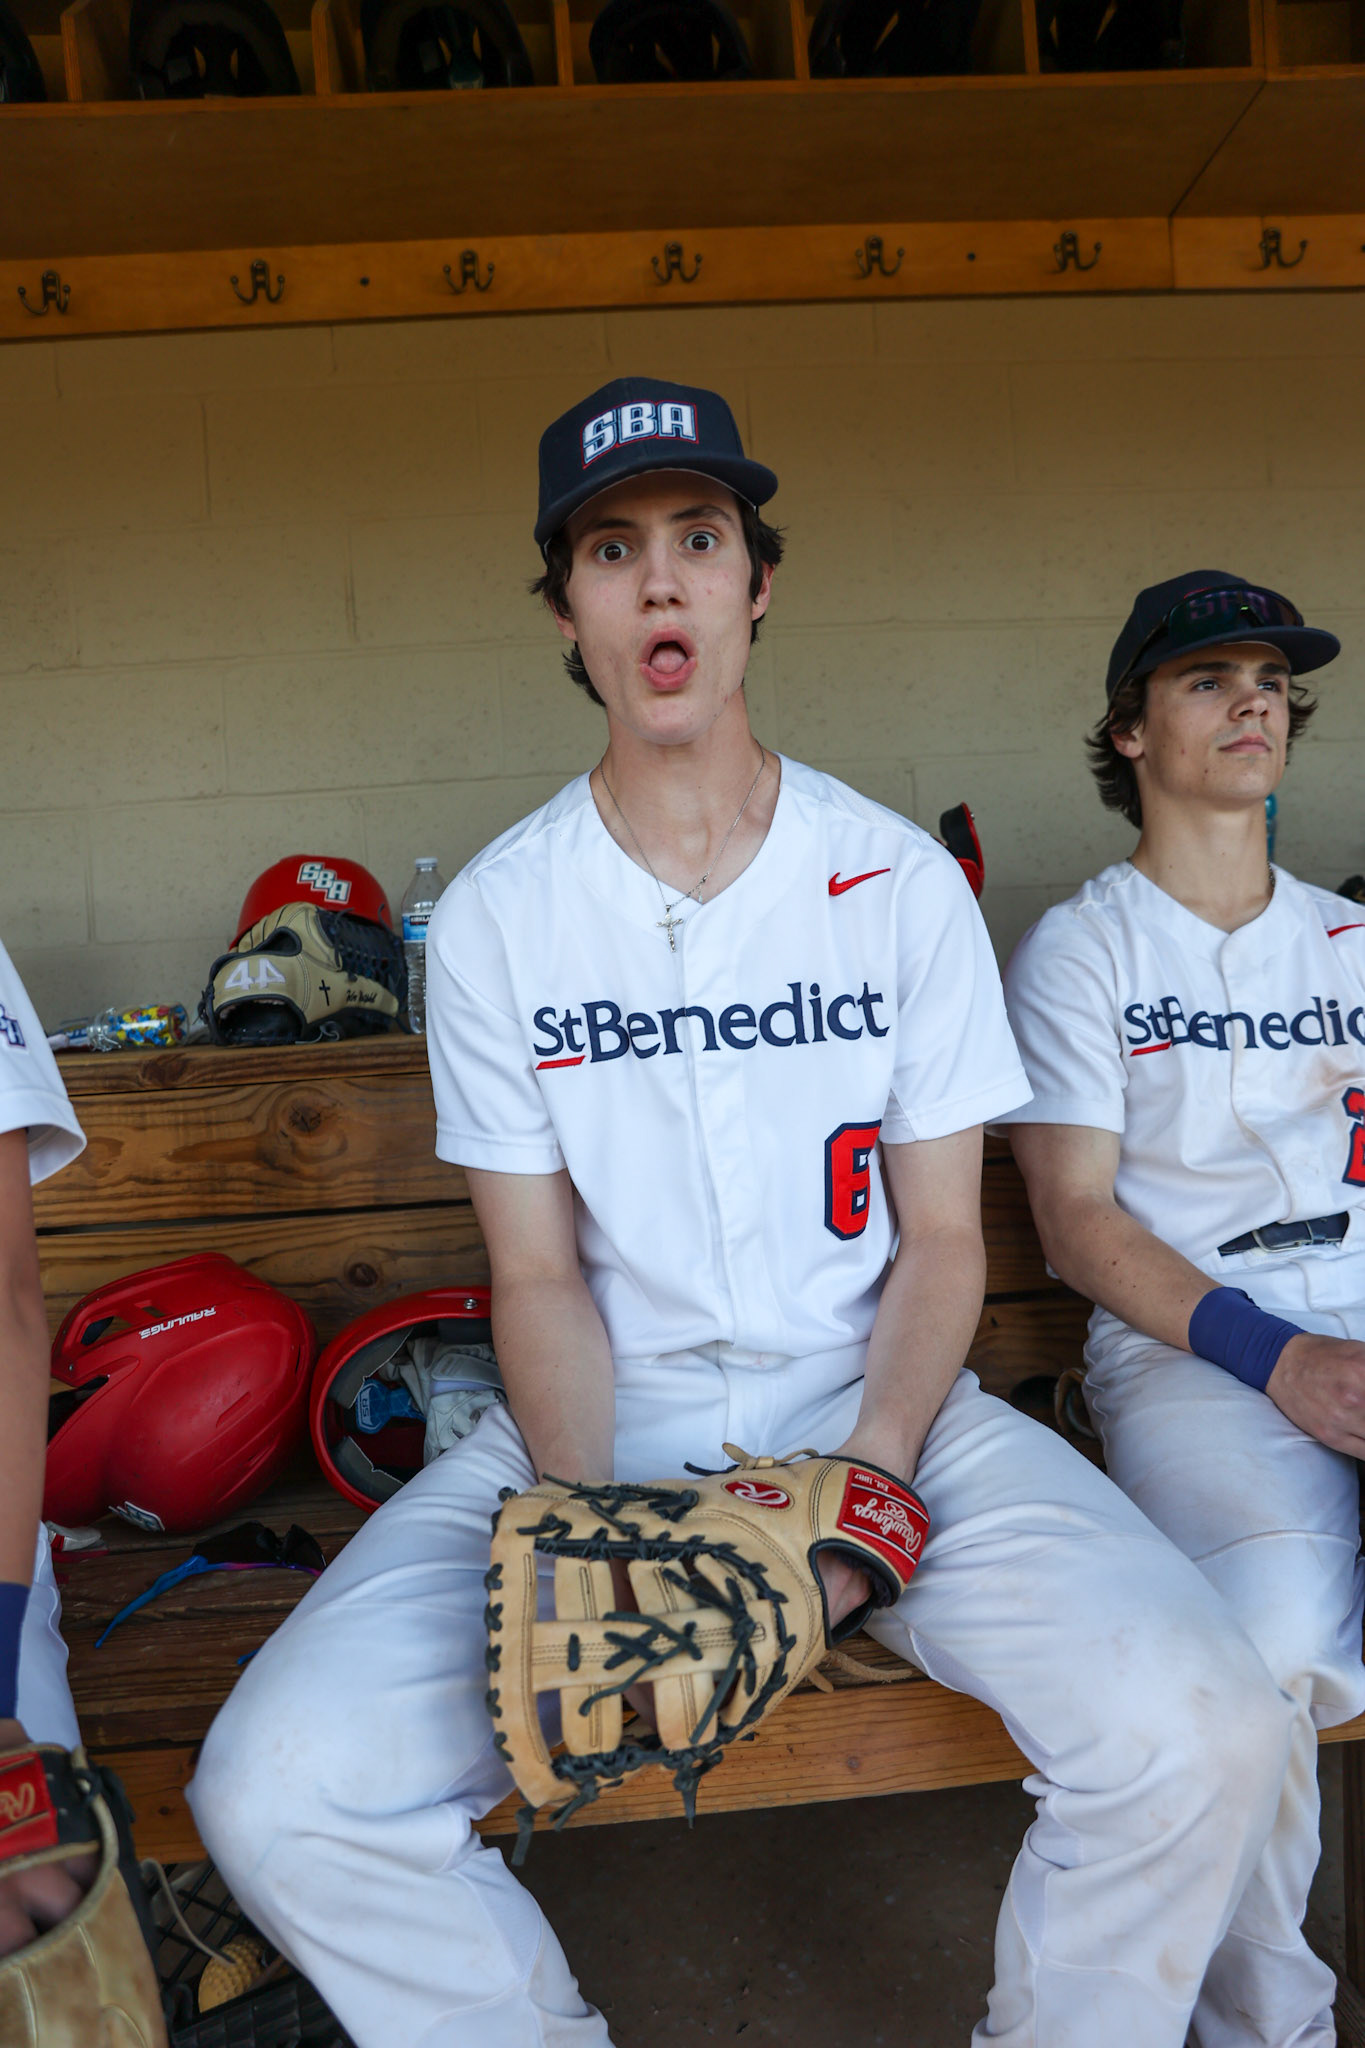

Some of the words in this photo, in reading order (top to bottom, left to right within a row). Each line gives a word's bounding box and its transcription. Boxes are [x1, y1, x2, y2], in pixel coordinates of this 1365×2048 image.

[581, 401, 698, 466] SBA
[298, 862, 351, 903] SBA
[224, 957, 286, 991] 44
[140, 1306, 217, 1339] RAWLINGS
[875, 1480, 889, 1493] Est.
[852, 1498, 921, 1553] Rawlings
